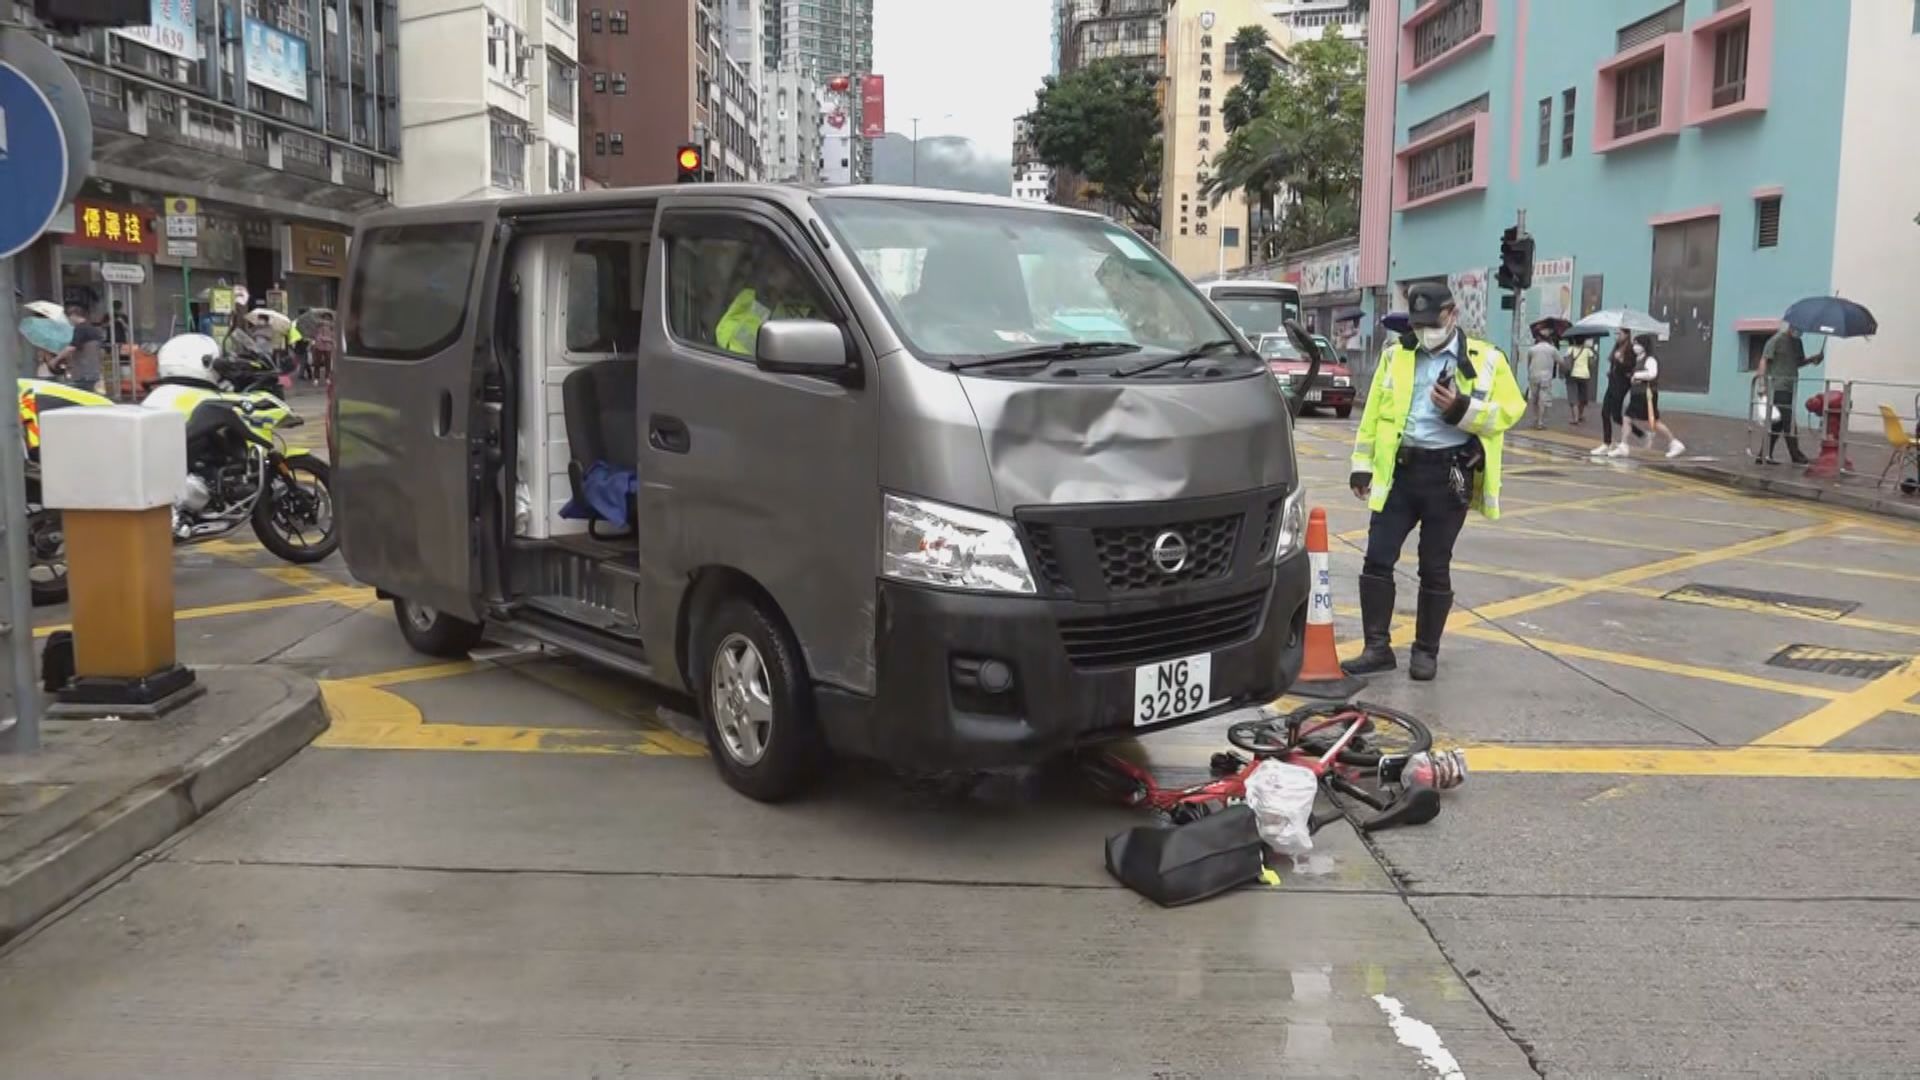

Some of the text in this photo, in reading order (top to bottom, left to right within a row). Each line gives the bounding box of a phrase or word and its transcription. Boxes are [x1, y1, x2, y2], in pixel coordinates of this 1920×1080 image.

[156, 24, 184, 51] 1639
[1158, 660, 1188, 691] NG
[1140, 683, 1203, 720] 3289
